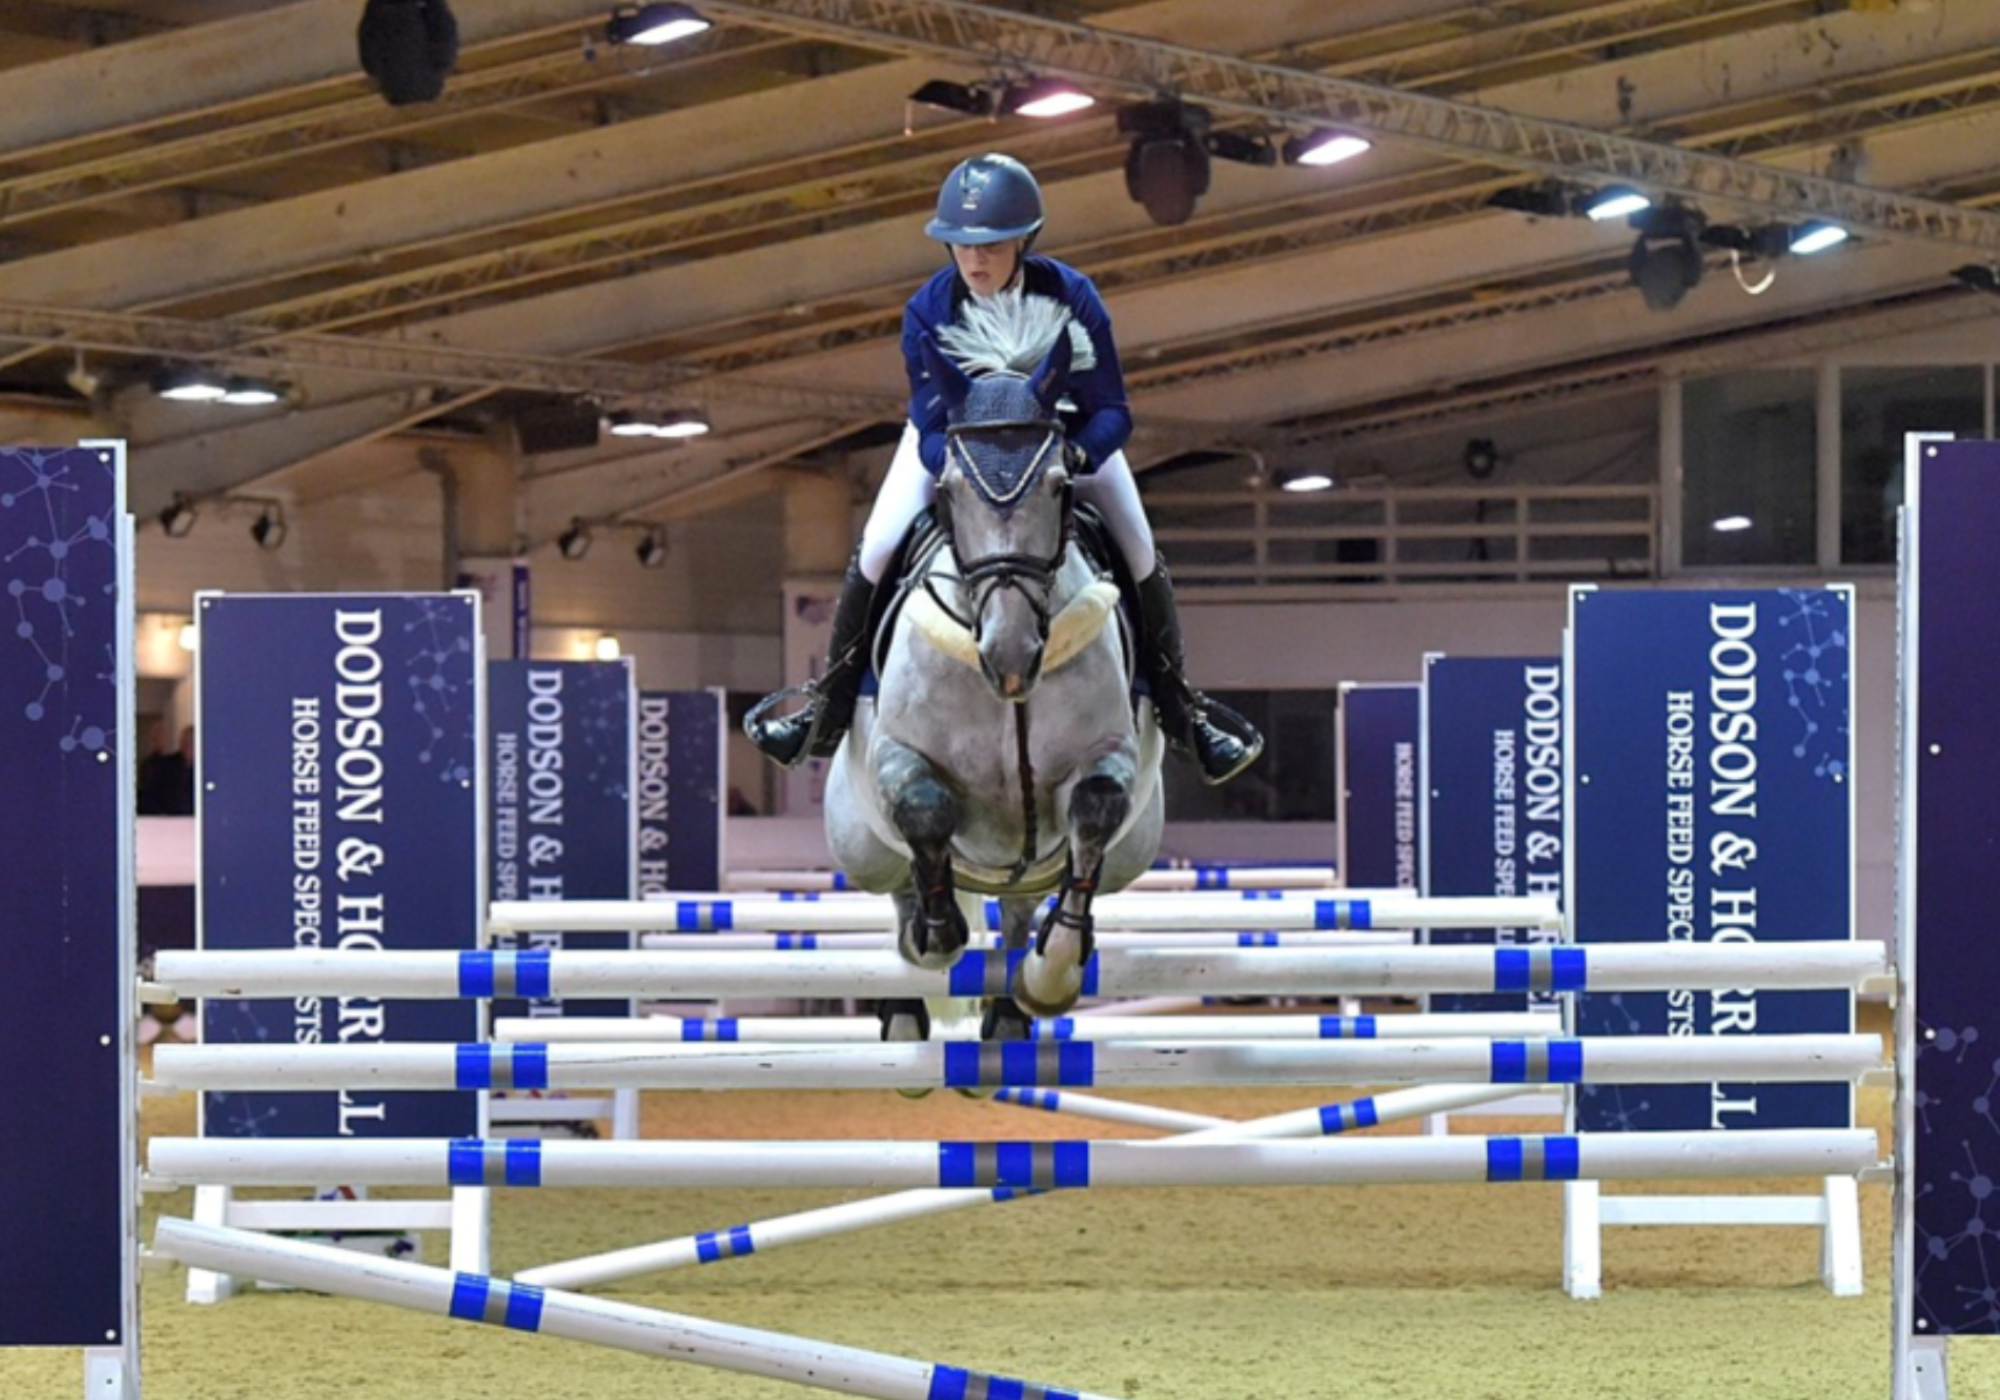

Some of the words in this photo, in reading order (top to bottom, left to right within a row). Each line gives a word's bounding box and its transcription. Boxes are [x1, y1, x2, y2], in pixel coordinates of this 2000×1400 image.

[335, 608, 383, 823] DODSON
[1525, 666, 1560, 822] DODSON
[1667, 691, 1694, 788] HORSE
[1709, 602, 1757, 817] DODSON
[292, 697, 320, 795] HORSE
[497, 733, 517, 804] HORSE
[528, 670, 562, 823] DODSON
[640, 698, 668, 820] DODSON
[1494, 730, 1515, 800] HORSE
[293, 800, 320, 870] FEED
[336, 837, 384, 881] &
[498, 807, 517, 859] FEED
[528, 835, 563, 866] &
[641, 828, 668, 853] &
[1495, 804, 1515, 856] FEED
[1526, 831, 1561, 864] &
[1667, 793, 1694, 864] FEED
[1710, 831, 1757, 875] &
[293, 874, 322, 1043] SPECSTS
[1667, 868, 1695, 1036] SPECSTS
